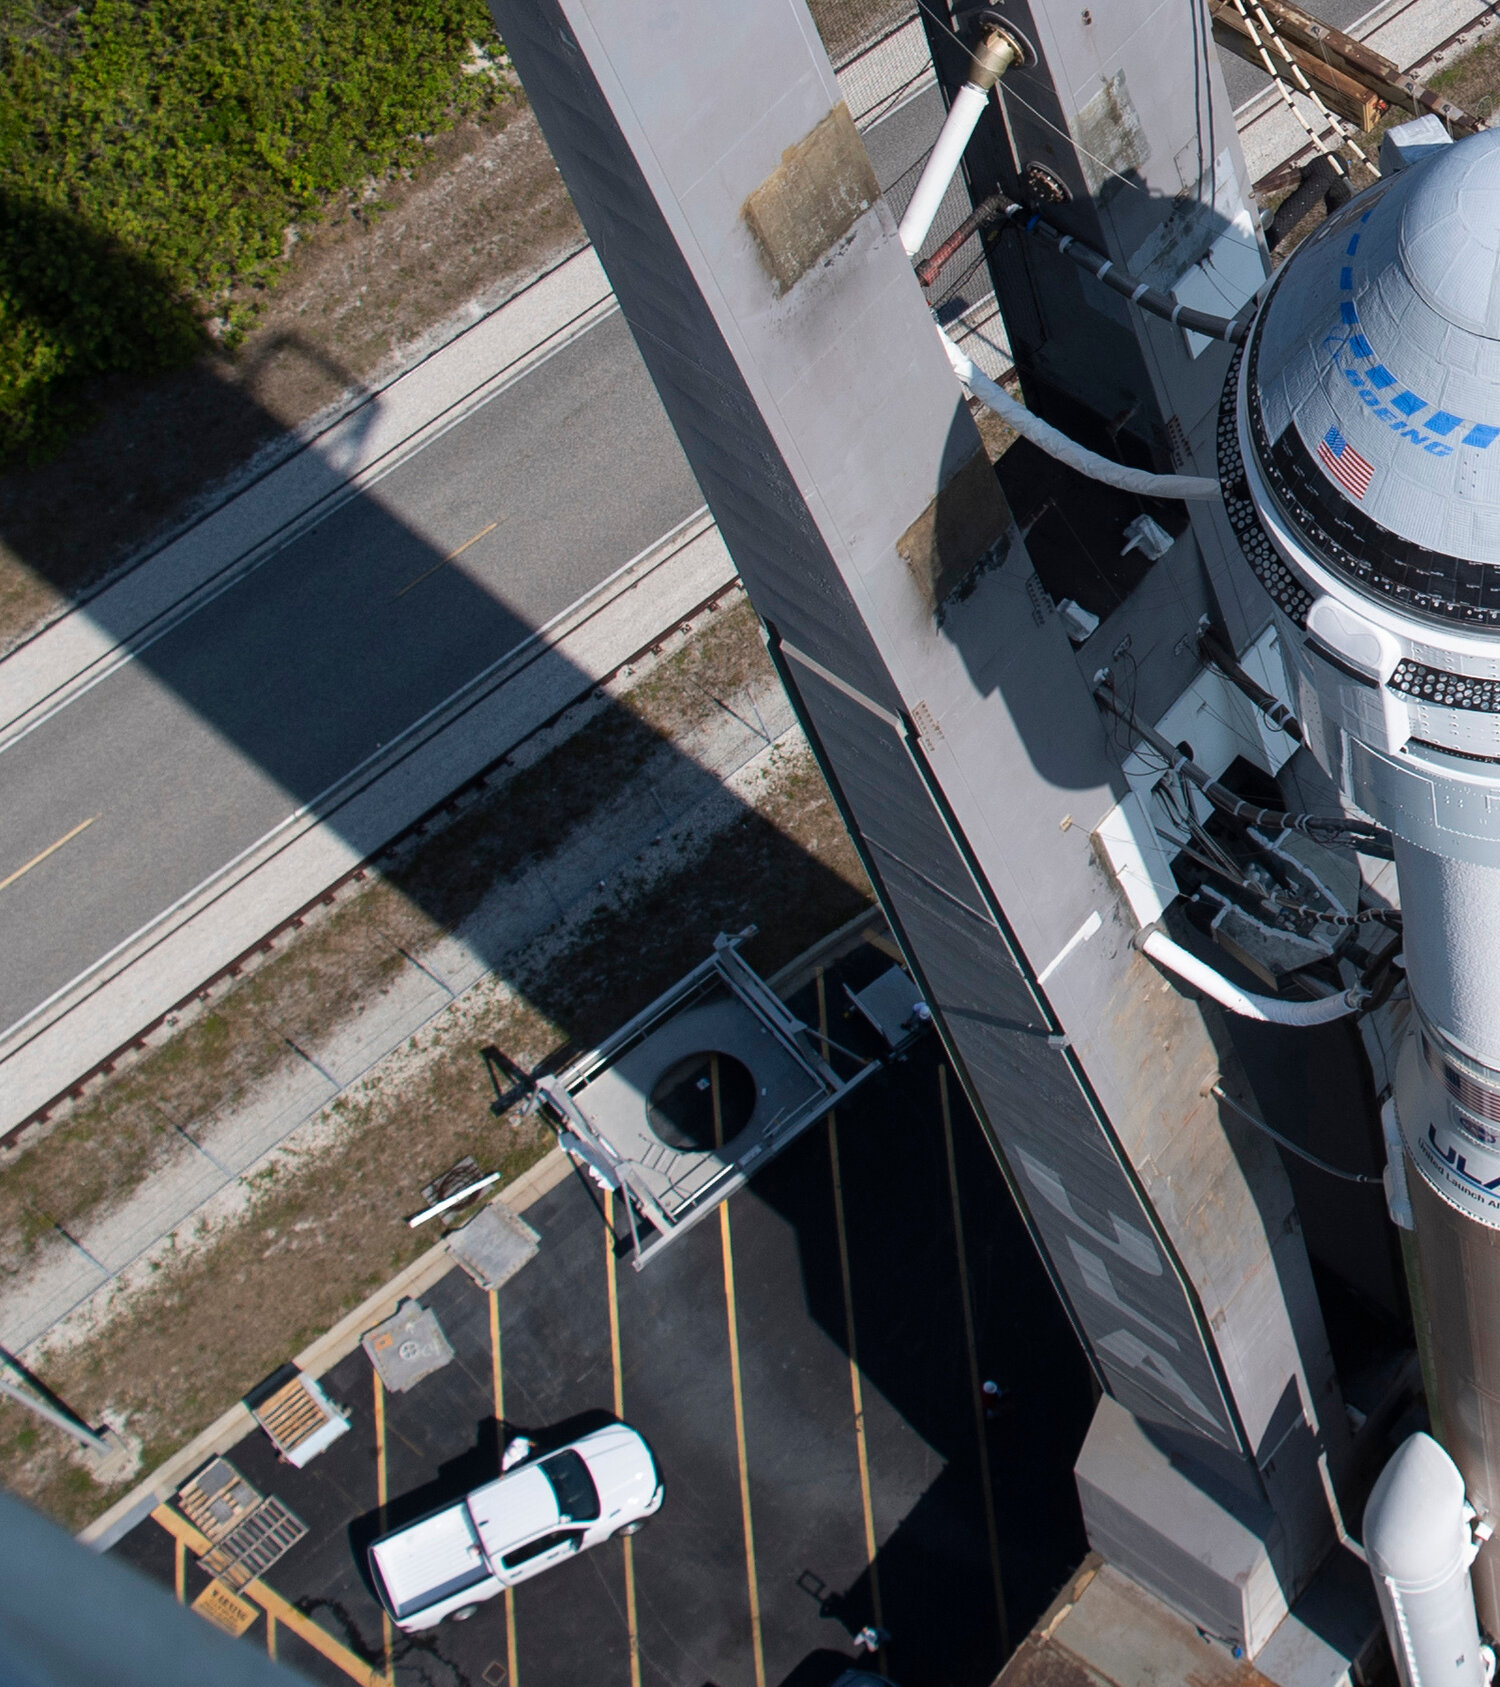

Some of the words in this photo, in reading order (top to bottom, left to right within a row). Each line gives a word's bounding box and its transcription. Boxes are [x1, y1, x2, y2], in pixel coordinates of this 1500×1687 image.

[1344, 368, 1454, 457] BOEING
[1418, 1136, 1445, 1175] United
[1446, 1172, 1485, 1204] Launch
[1015, 1145, 1226, 1433] ULA
